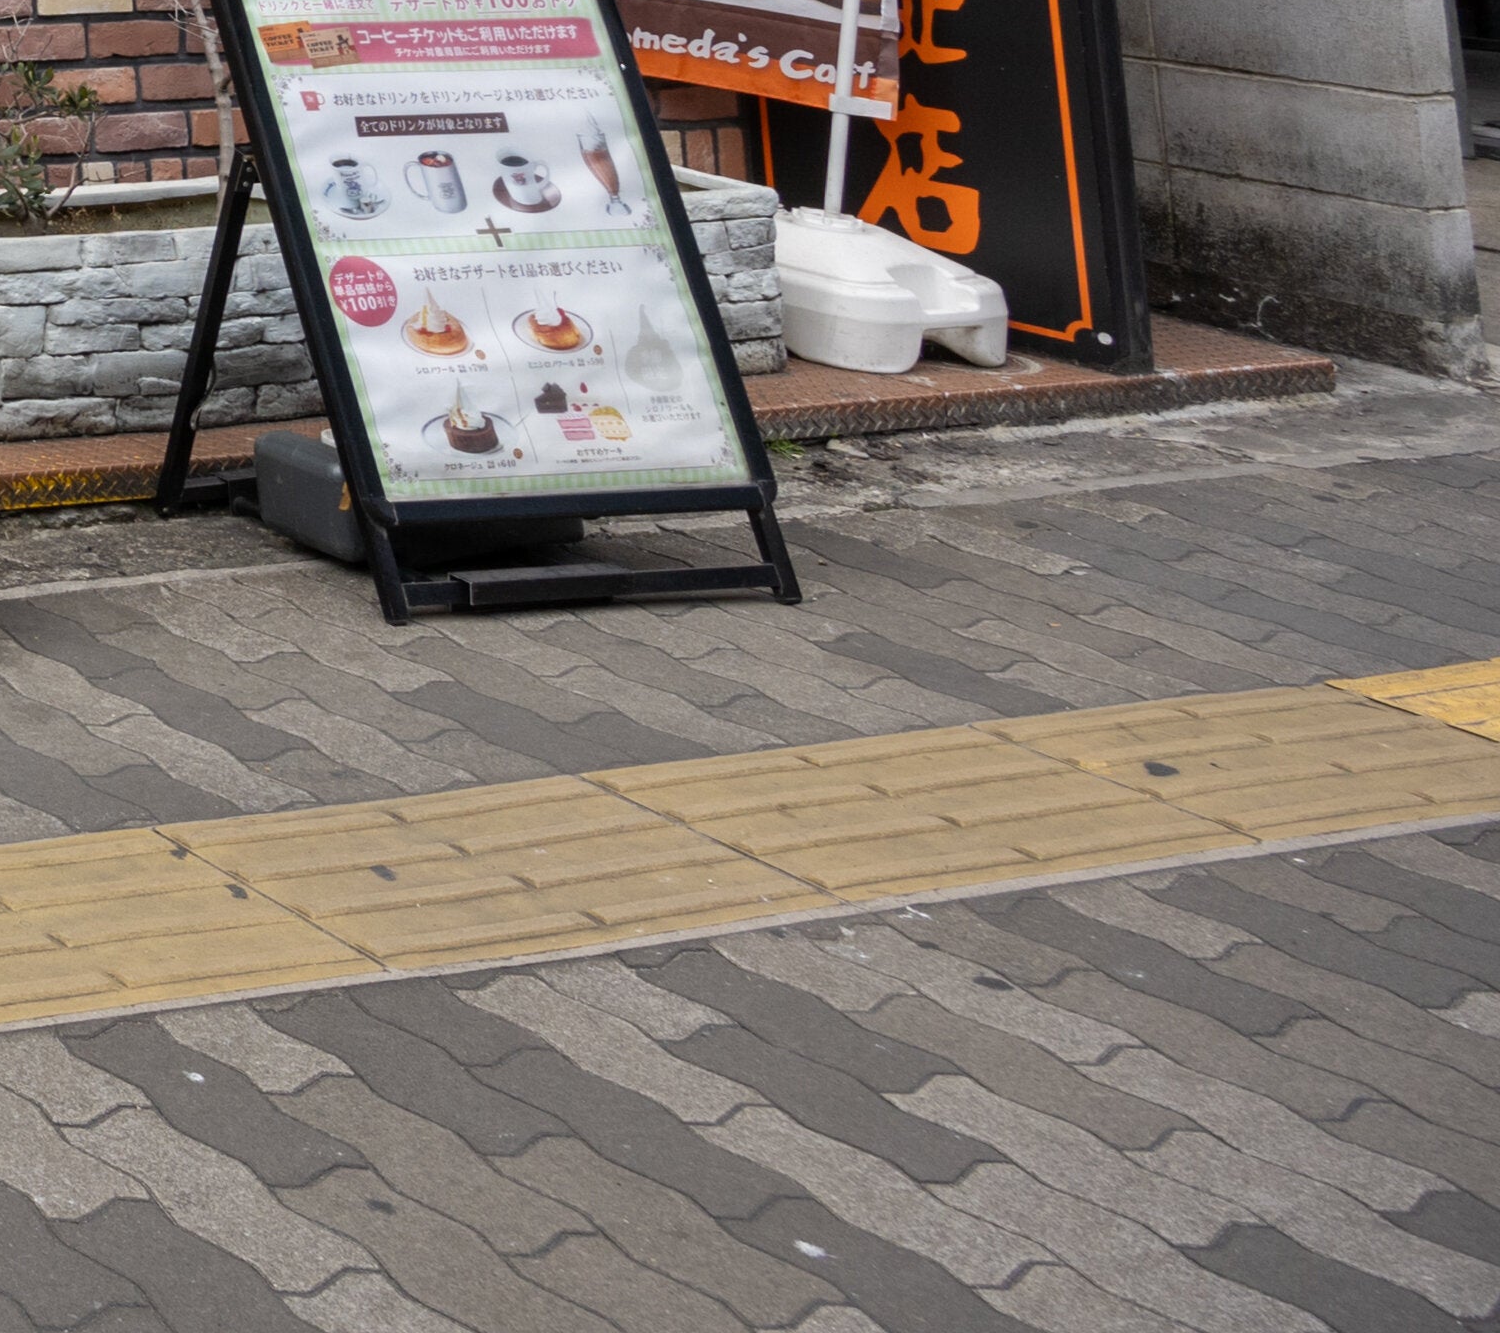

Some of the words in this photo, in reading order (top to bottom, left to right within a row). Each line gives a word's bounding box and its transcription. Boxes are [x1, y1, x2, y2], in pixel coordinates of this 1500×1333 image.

[357, 24, 578, 45] コーヒーチケットもご利用いただけます
[359, 116, 503, 134] 全てのドリンクが対象となります
[334, 271, 385, 283] デザートが
[334, 281, 394, 297] 単品価格から
[340, 294, 397, 313] ¥100引き
